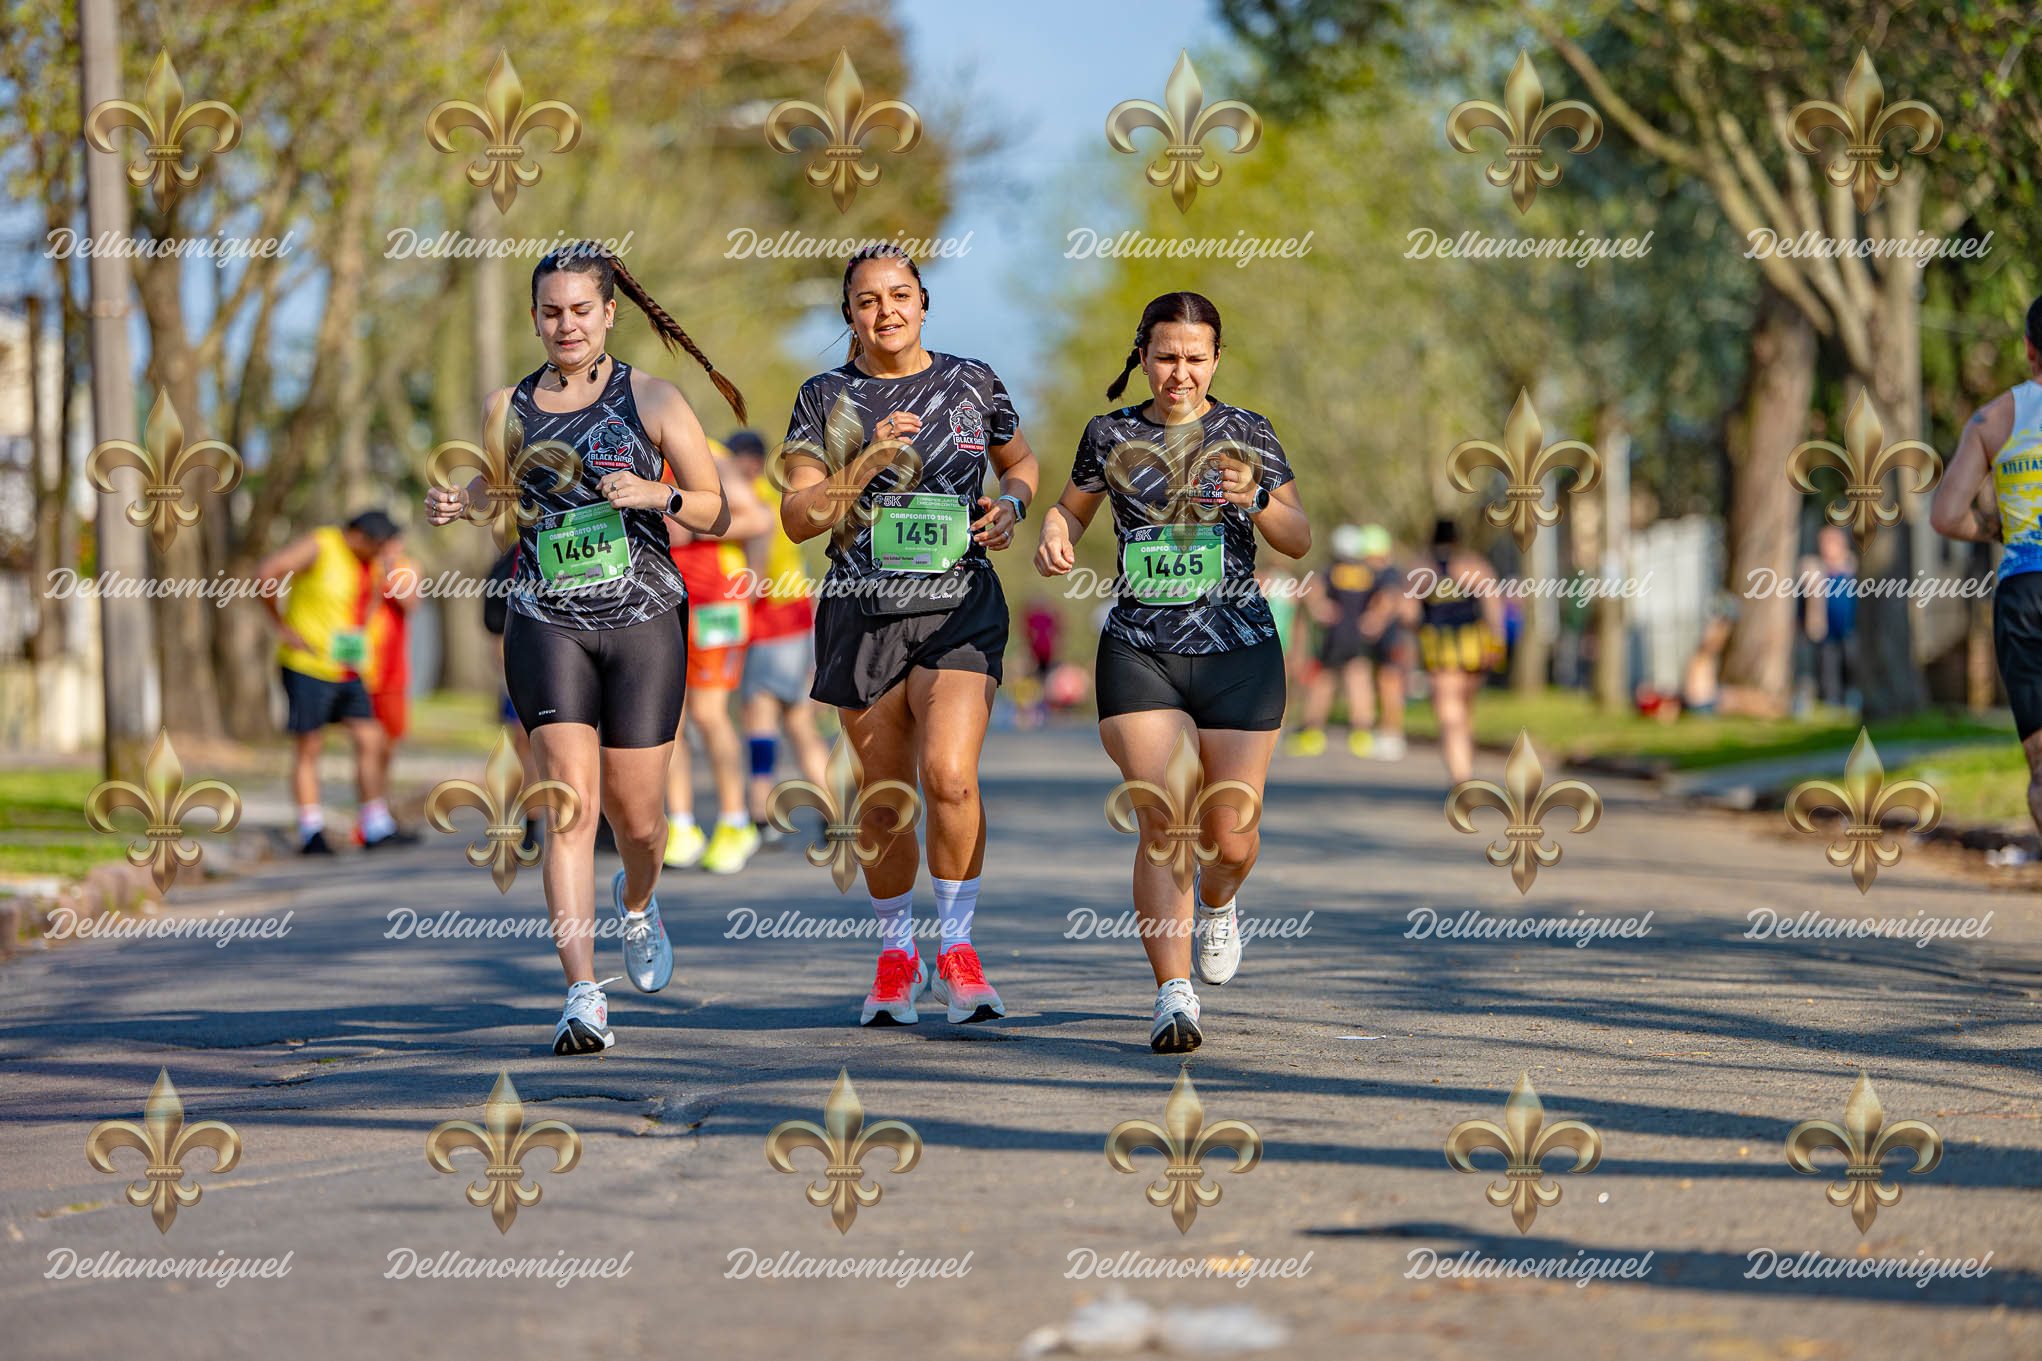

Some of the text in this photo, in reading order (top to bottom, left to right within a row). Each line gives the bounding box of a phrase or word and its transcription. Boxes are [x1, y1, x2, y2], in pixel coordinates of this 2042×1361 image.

[955, 436, 973, 444] BLACK
[590, 453, 612, 461] BLACK
[883, 495, 901, 507] 5K
[890, 512, 936, 520] CAMPEONATO
[549, 526, 592, 541] CAMPEONATO
[895, 521, 948, 545] 1451
[1135, 528, 1152, 542] 5K
[552, 532, 612, 564] 1464
[1140, 545, 1187, 553] CAMPEONATO
[1144, 553, 1203, 578] 1465
